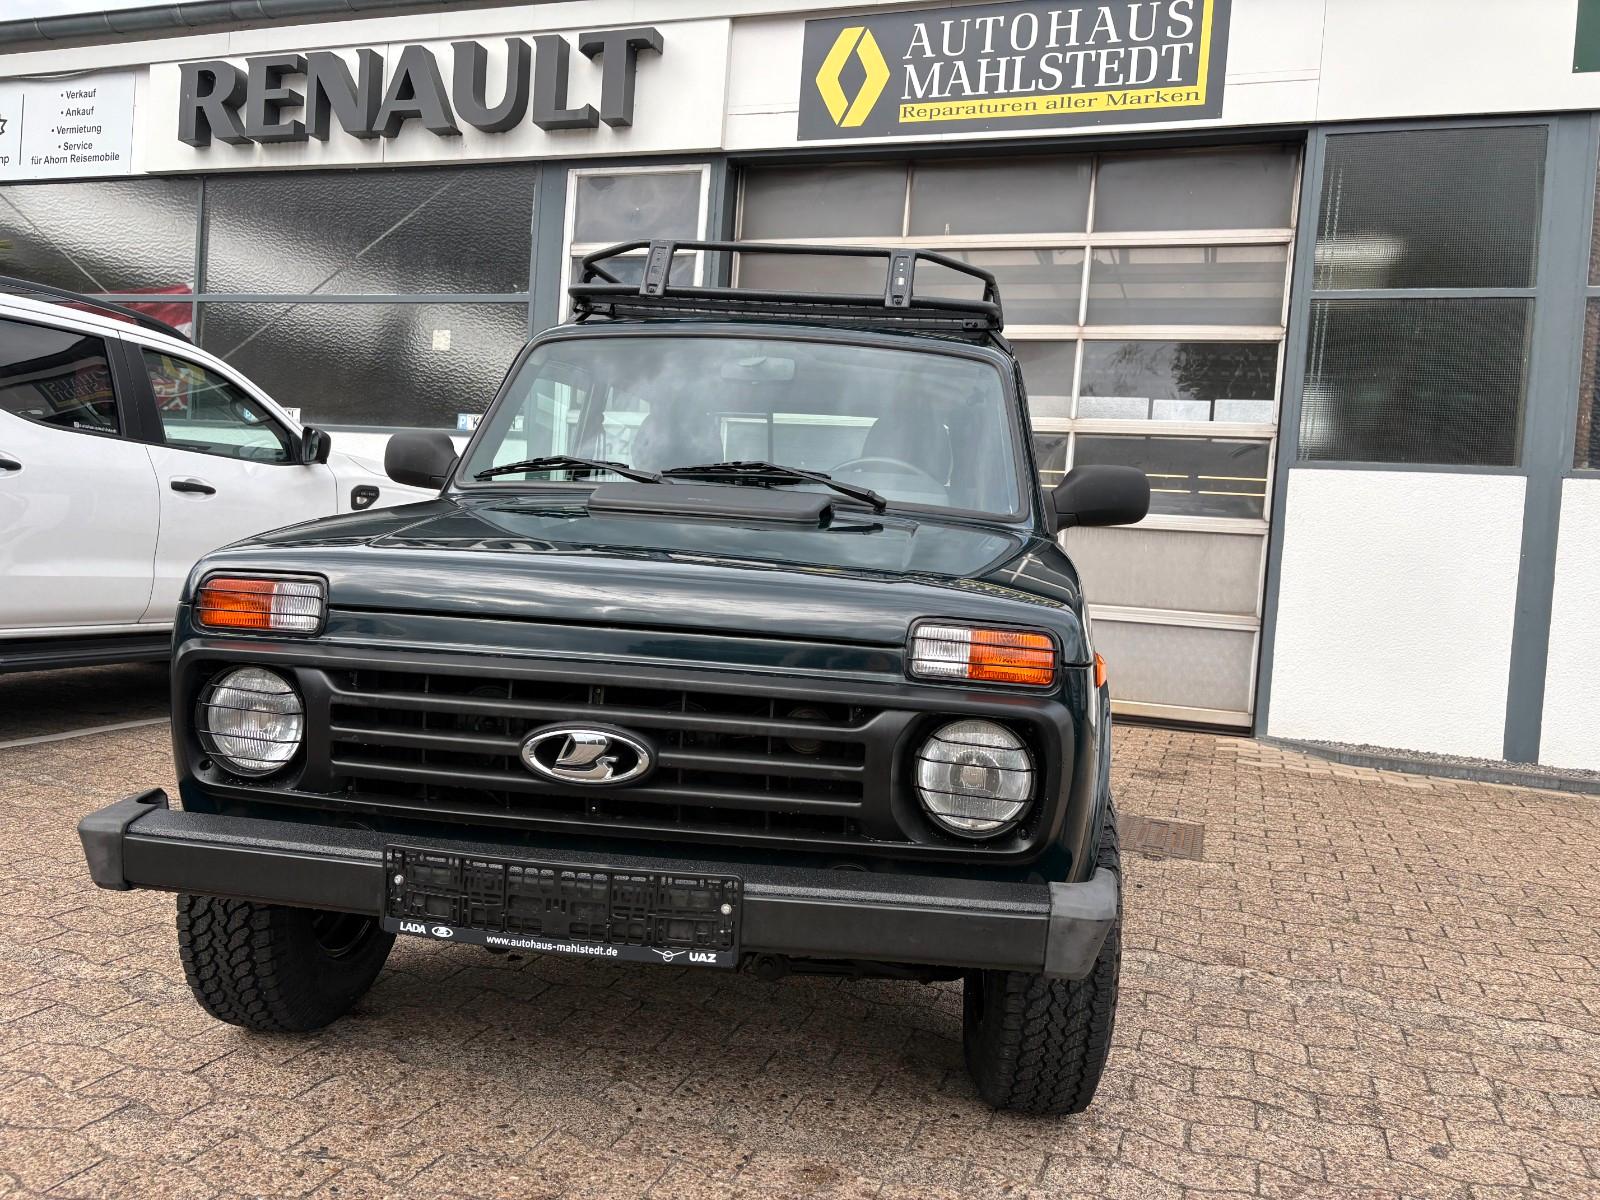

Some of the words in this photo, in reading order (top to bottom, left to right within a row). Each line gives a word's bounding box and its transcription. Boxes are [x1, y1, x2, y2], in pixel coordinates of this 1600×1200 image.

[902, 0, 1195, 60] AUTOHAUS
[900, 42, 1194, 100] MAHLSTEDT
[66, 88, 97, 99] Verkauf
[178, 27, 664, 148] RENAULT
[65, 106, 94, 117] Ankauf
[901, 98, 1038, 121] Reparaturen
[1045, 94, 1098, 111] aller
[1104, 90, 1200, 107] Marken
[56, 124, 102, 135] Vermietung
[63, 141, 93, 151] Service
[31, 156, 43, 165] für
[43, 154, 68, 165] Ahorn
[70, 151, 120, 163] Reisemobile
[399, 921, 427, 934] LADA
[486, 935, 618, 957] www.autohaus-mahlstedt.de
[689, 951, 717, 963] UAZ
